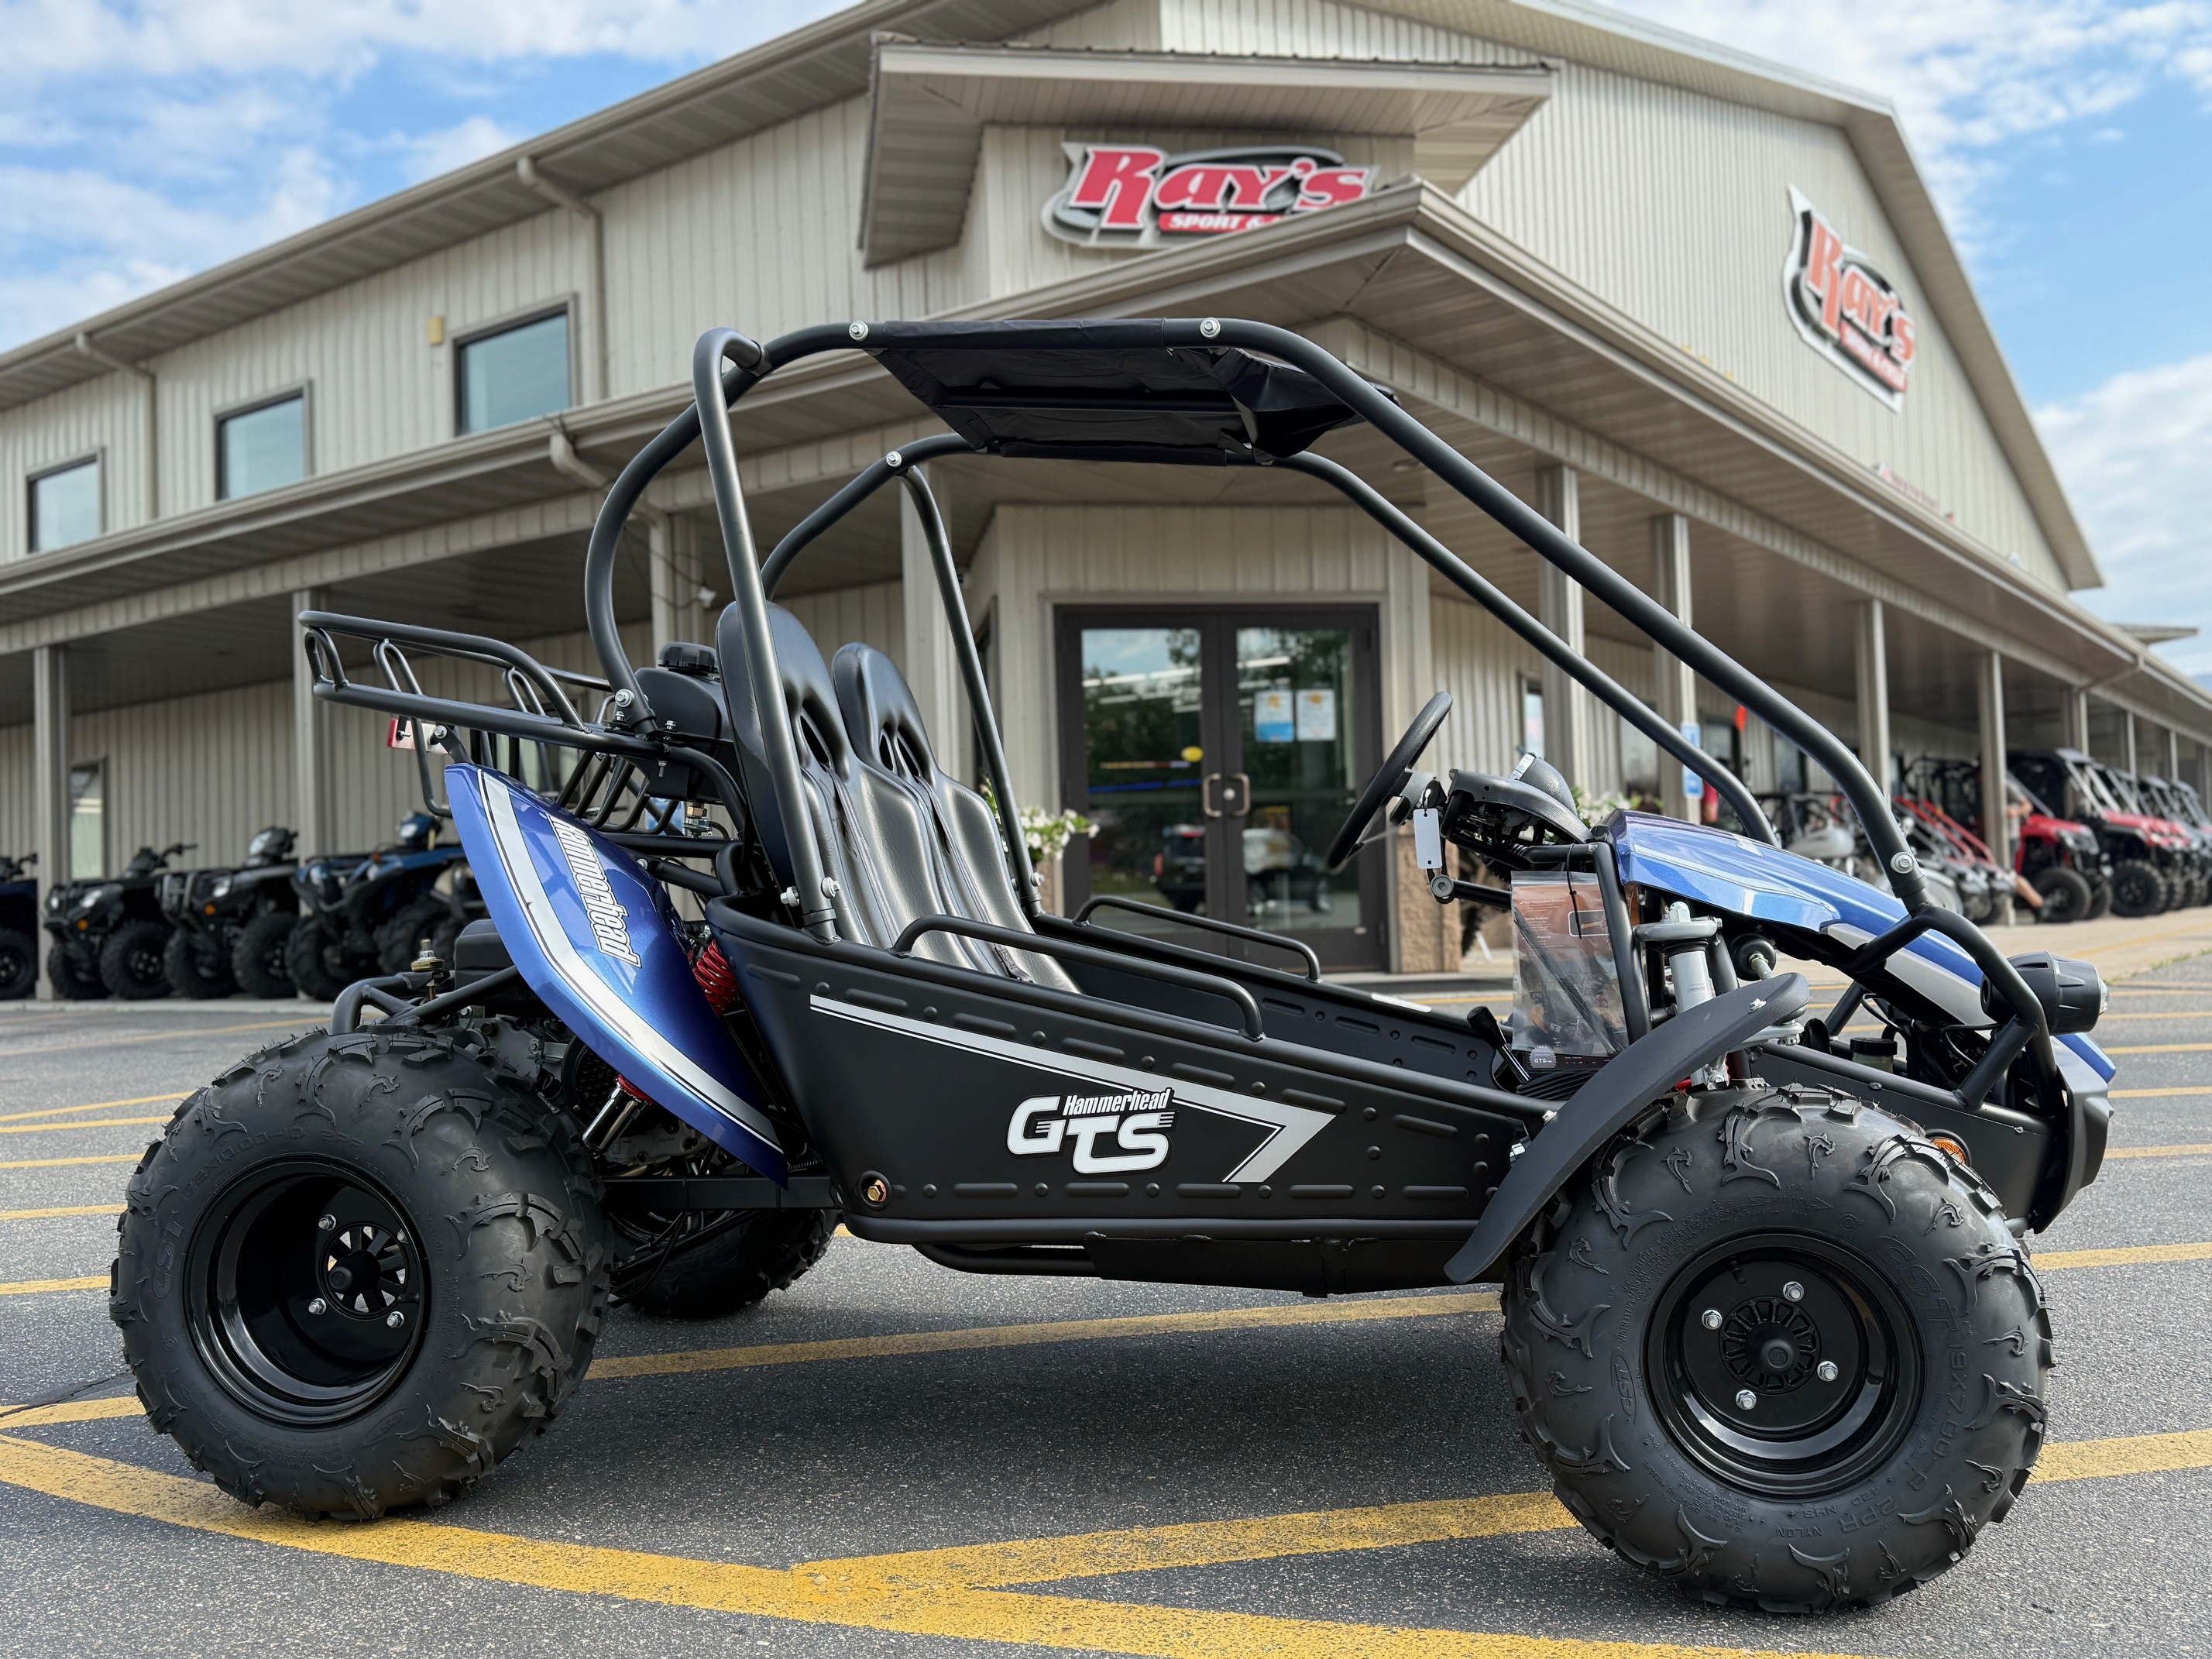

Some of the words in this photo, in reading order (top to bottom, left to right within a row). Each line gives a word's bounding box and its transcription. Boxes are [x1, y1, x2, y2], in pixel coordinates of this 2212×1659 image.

[1069, 146, 1370, 228] Ray's
[1168, 214, 1244, 229] SPORT
[1806, 216, 1915, 366] Ray's
[547, 813, 642, 968] Hammerhead
[1008, 1095, 1176, 1174] GTS
[1063, 1088, 1172, 1116] Hammerhead
[153, 1219, 184, 1299] CST
[1661, 1218, 1702, 1252] OPERATING
[1615, 1300, 1634, 1342] WARNING
[1874, 1235, 1960, 1331] CST
[1776, 1525, 1822, 1539] NYLON
